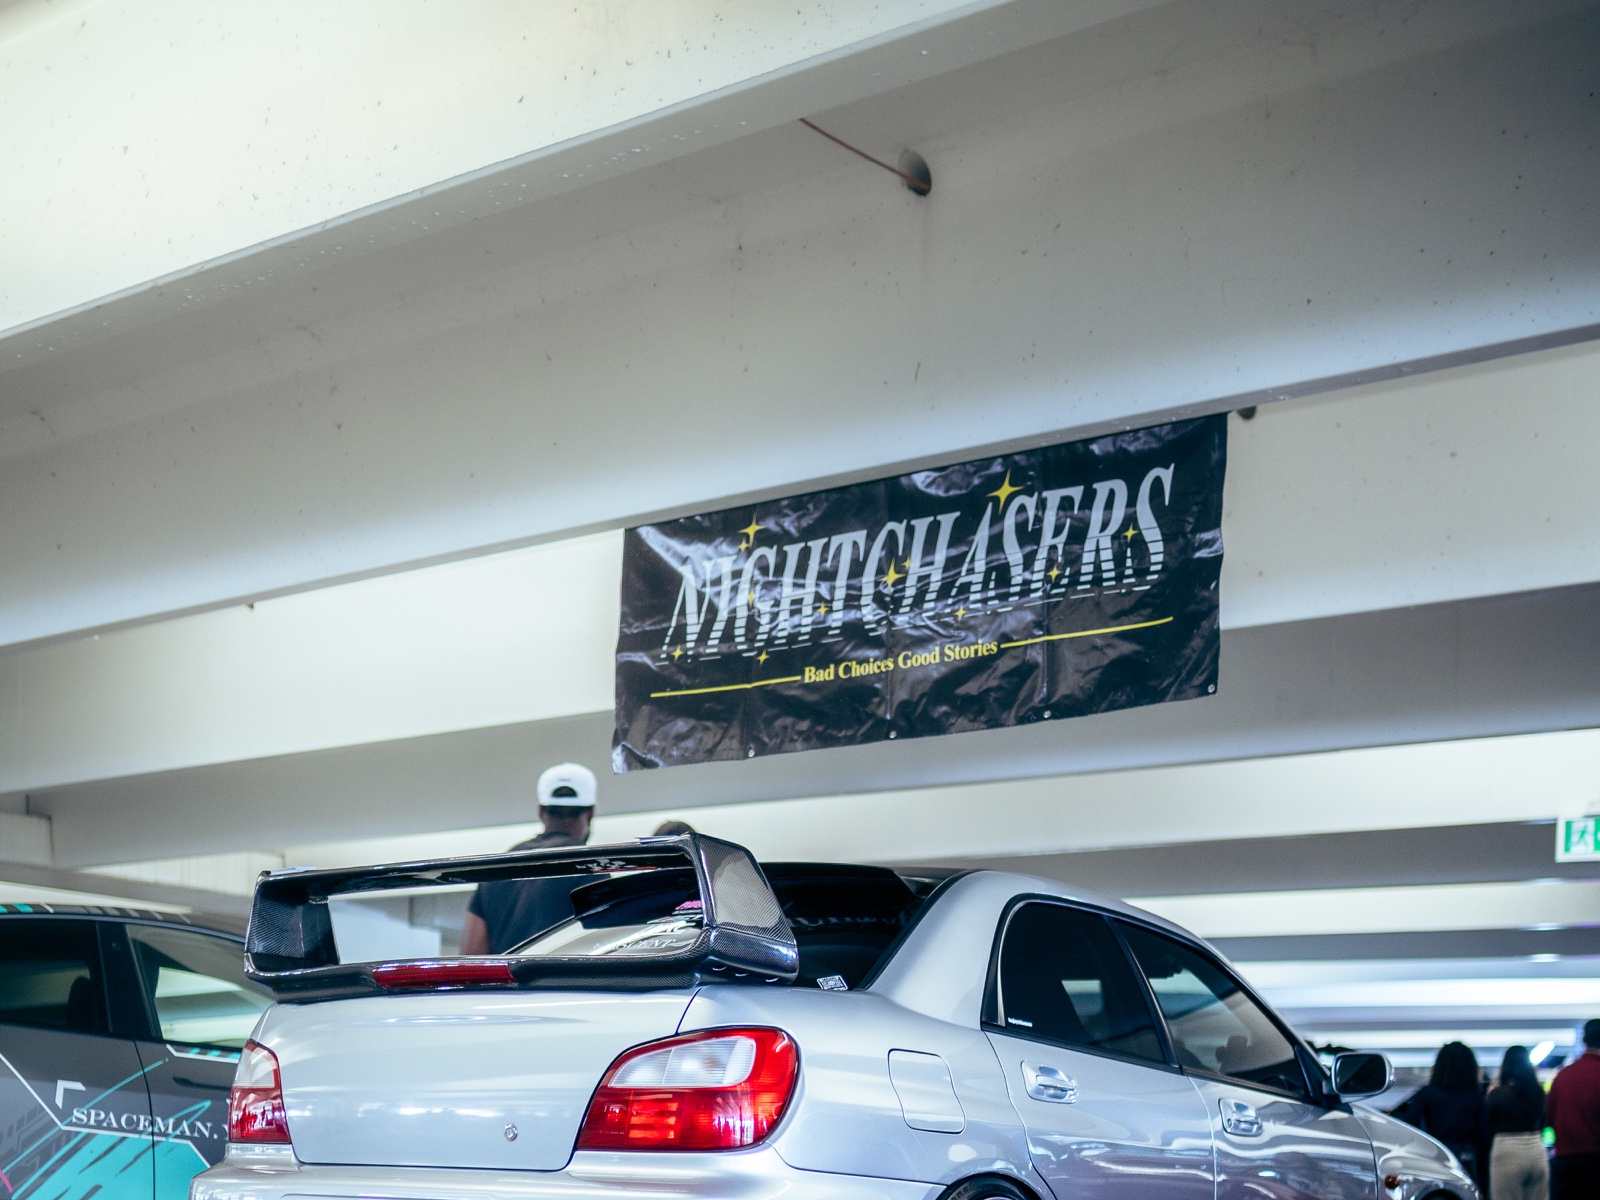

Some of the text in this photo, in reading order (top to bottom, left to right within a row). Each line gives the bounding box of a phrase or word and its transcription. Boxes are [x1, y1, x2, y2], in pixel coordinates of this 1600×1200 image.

[655, 463, 1175, 664] NIGHTCHASERS
[803, 640, 999, 683] Bad Choices Good Stories
[72, 1107, 228, 1140] SPACEMAN.
